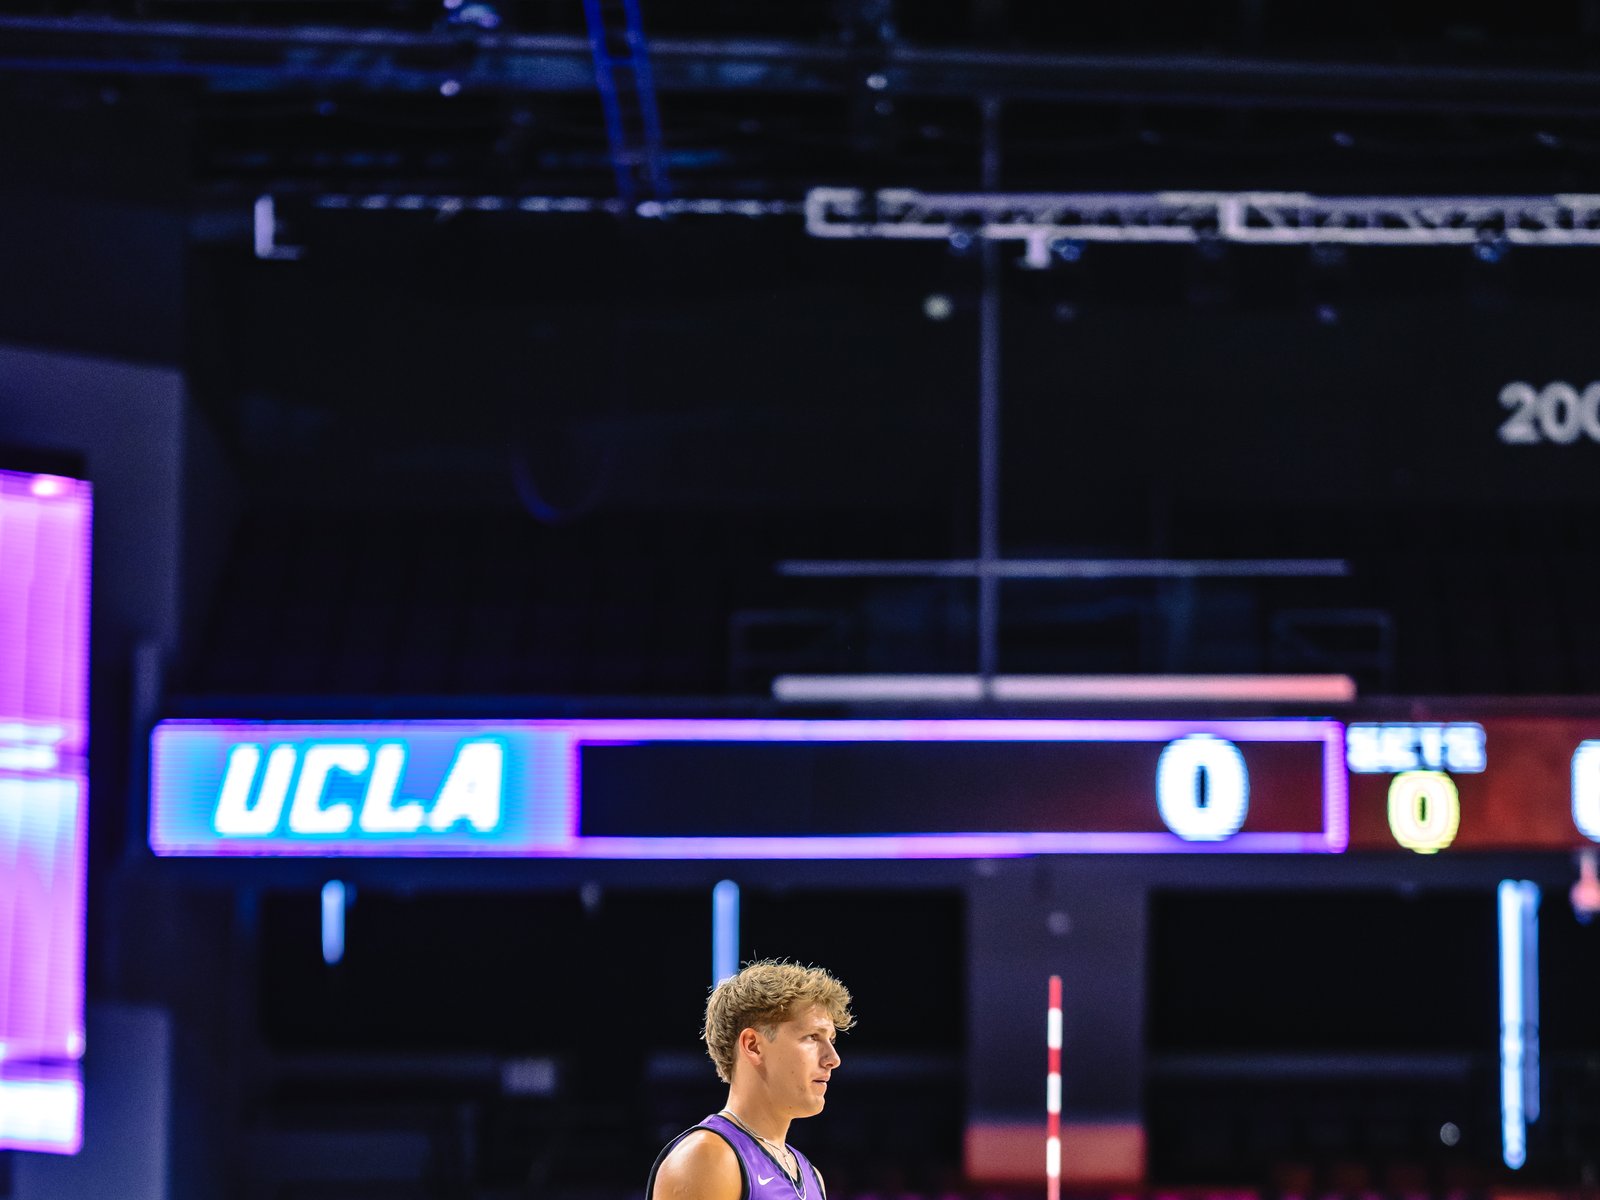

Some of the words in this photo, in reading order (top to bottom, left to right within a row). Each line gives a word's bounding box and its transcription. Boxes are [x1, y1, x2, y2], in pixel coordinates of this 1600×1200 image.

[213, 741, 504, 835] UCLA
[1156, 733, 1250, 841] 0
[1388, 769, 1460, 854] 0
